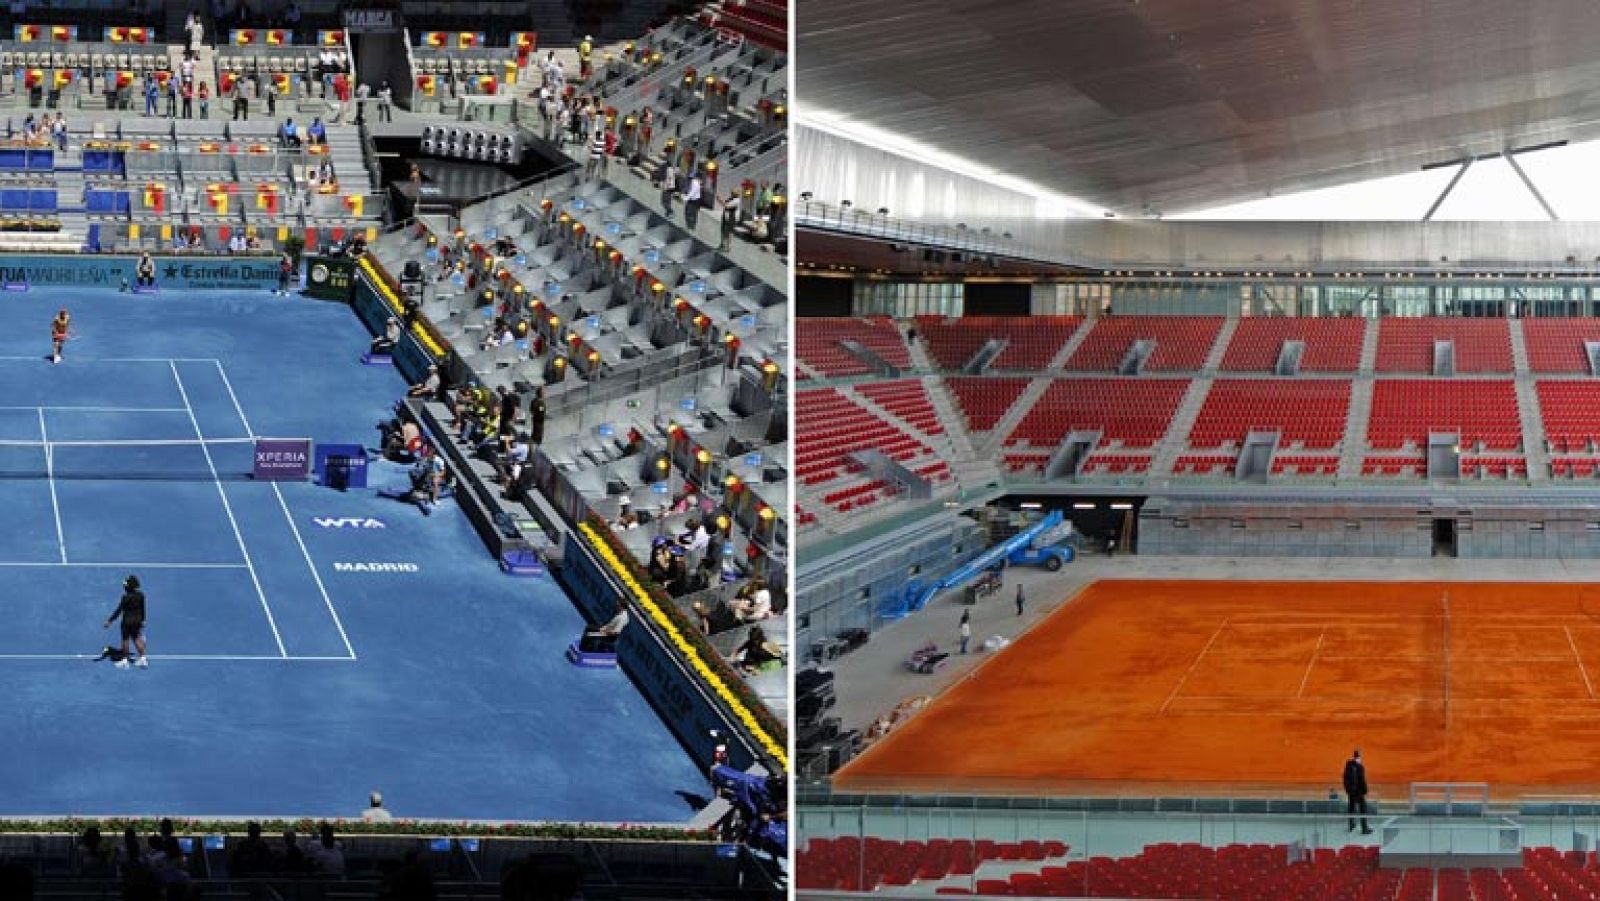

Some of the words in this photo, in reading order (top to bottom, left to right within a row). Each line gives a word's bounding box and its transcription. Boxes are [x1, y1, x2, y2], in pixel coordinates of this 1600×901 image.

[181, 264, 238, 280] Estrella
[256, 452, 305, 462] XPERIA
[313, 517, 385, 529] WTA
[333, 562, 419, 572] MADRID
